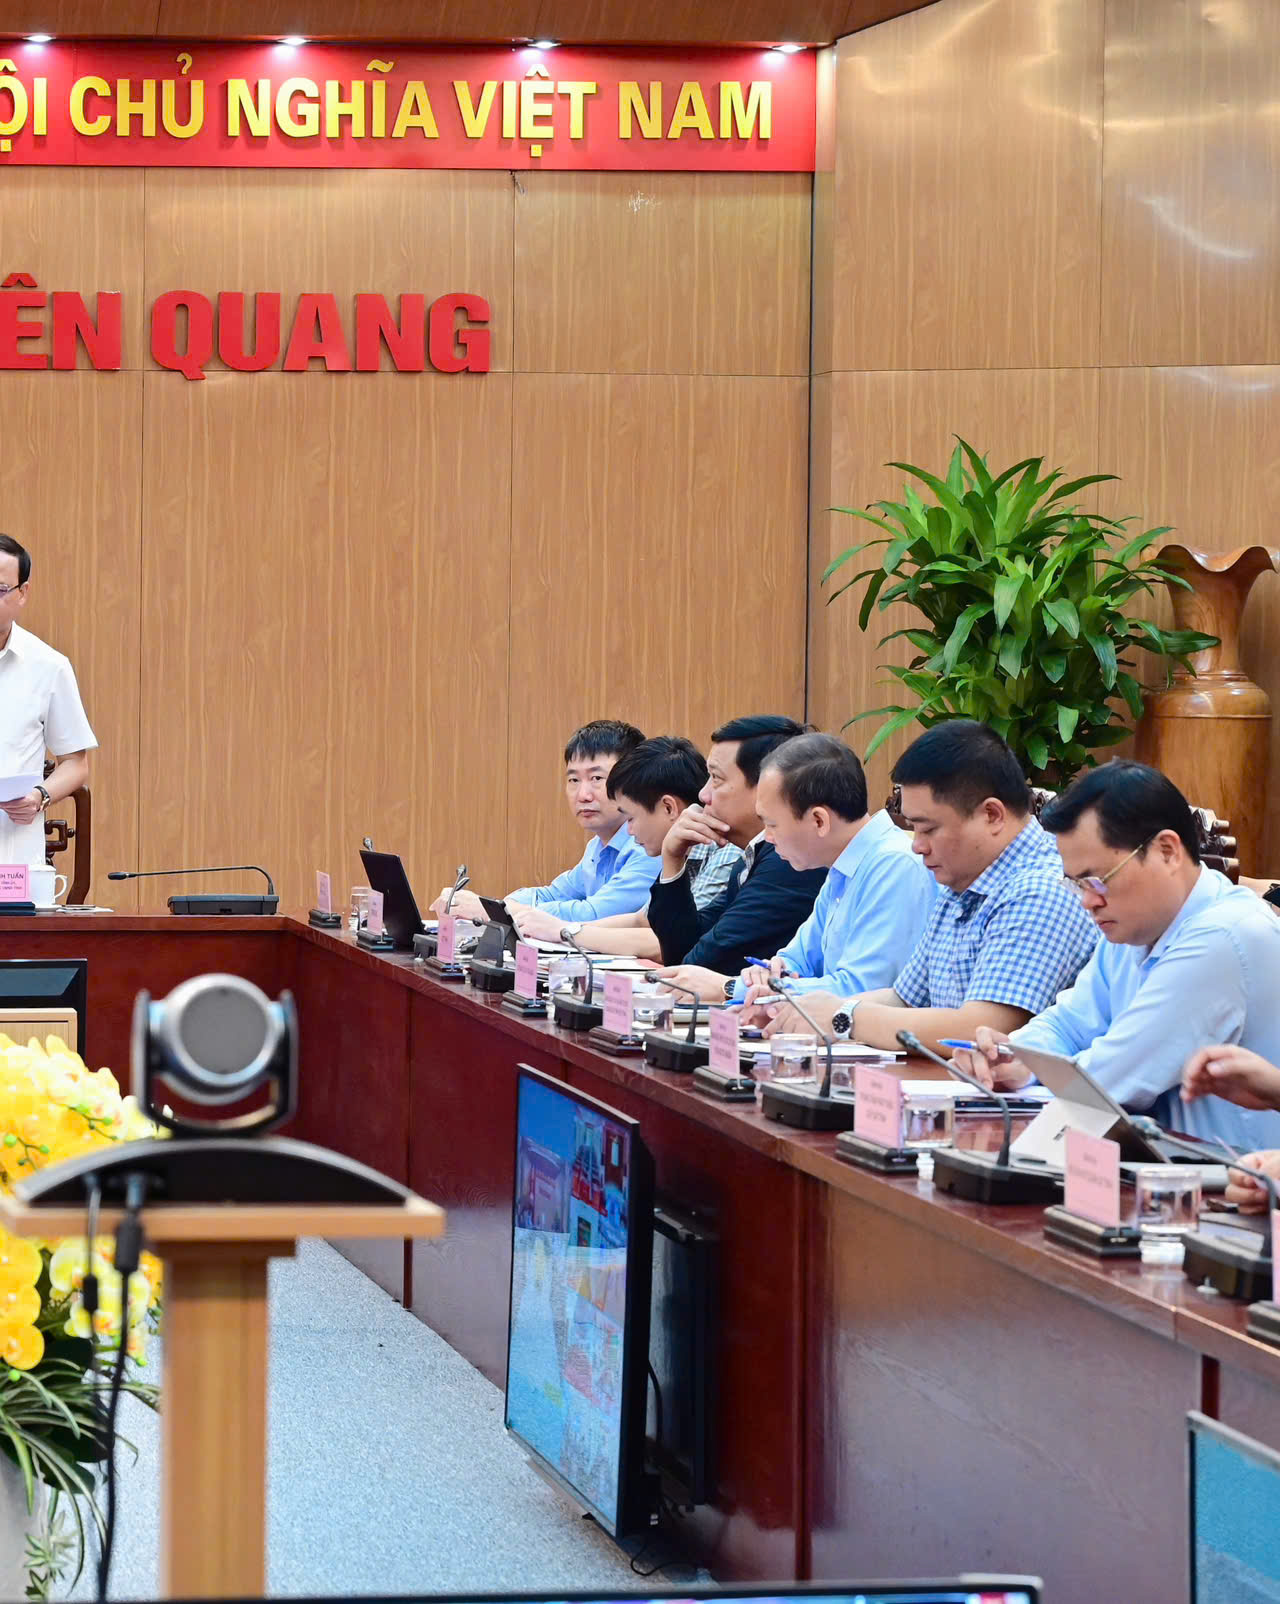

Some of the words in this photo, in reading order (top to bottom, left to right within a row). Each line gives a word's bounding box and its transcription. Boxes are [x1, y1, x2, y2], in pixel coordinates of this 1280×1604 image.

[69, 53, 205, 139] CHỦ
[227, 60, 440, 140] NGHĨA
[455, 64, 598, 158] VIỆT
[618, 80, 773, 140] NAM
[149, 288, 492, 381] QUANG
